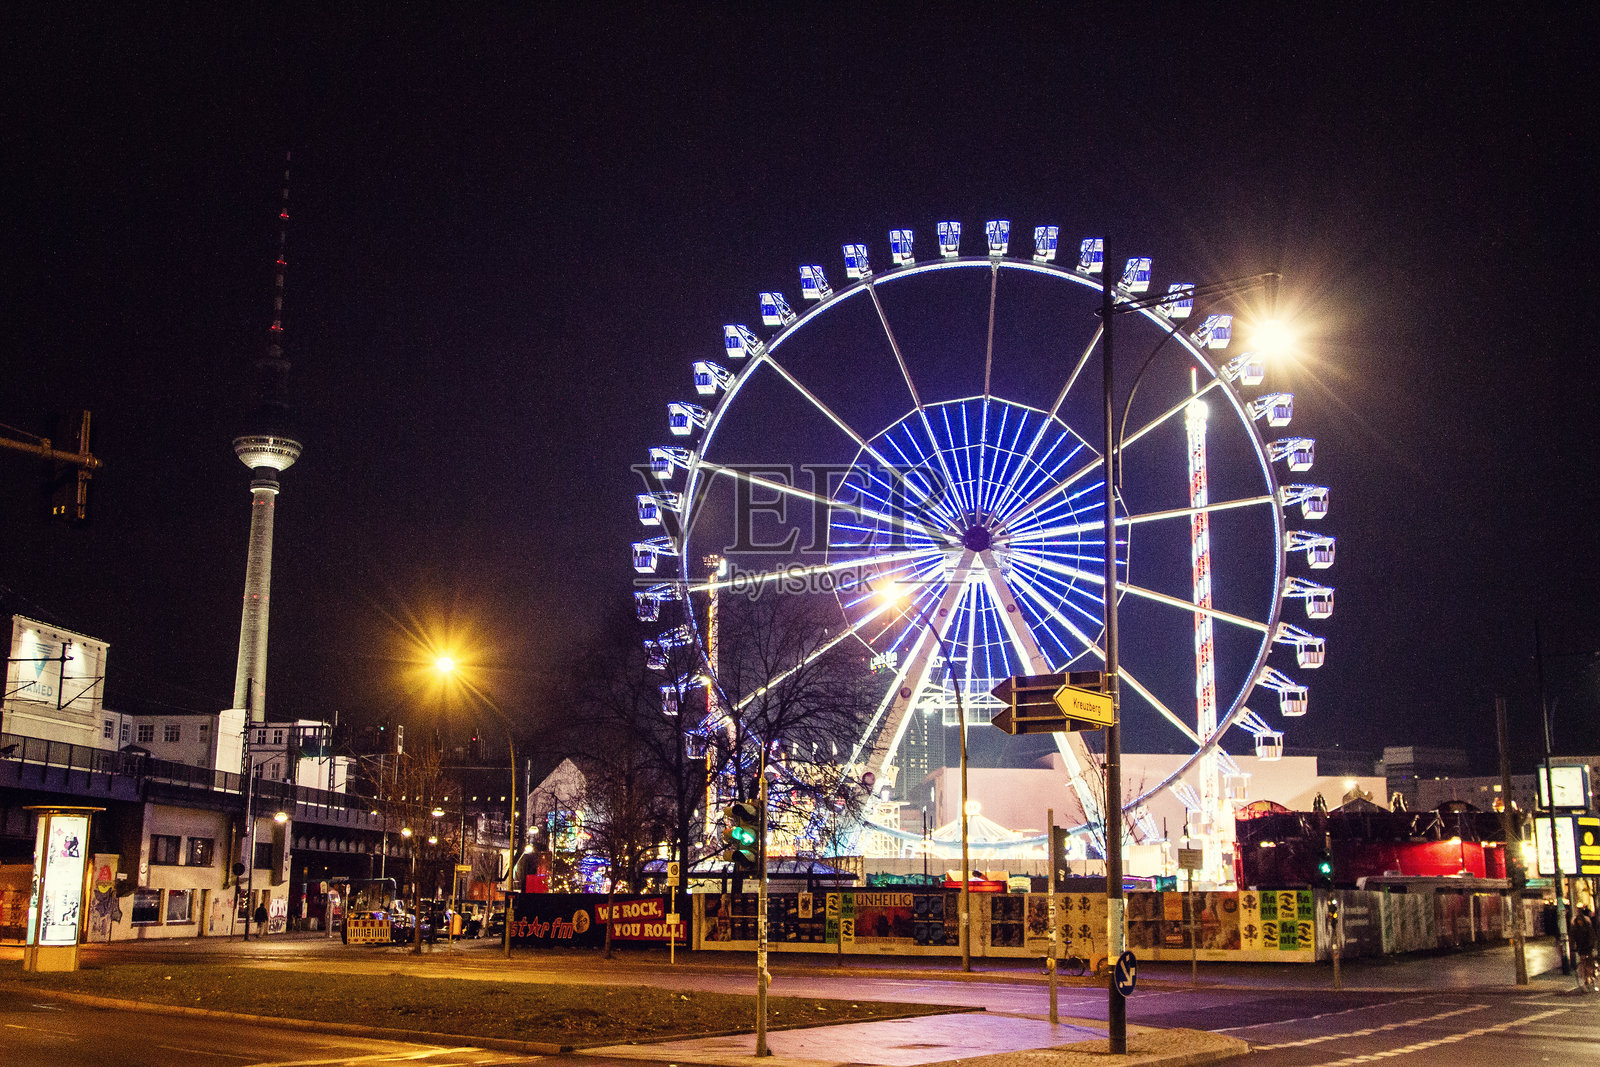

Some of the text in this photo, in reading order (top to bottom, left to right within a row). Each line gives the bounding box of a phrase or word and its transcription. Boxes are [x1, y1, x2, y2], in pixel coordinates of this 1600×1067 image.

[1073, 698, 1101, 716] Kreuzberg
[856, 894, 911, 905] UNHEILIG
[598, 901, 662, 920] WE ROCK,
[551, 917, 573, 938] fm
[614, 923, 684, 938] YOU ROLL!
